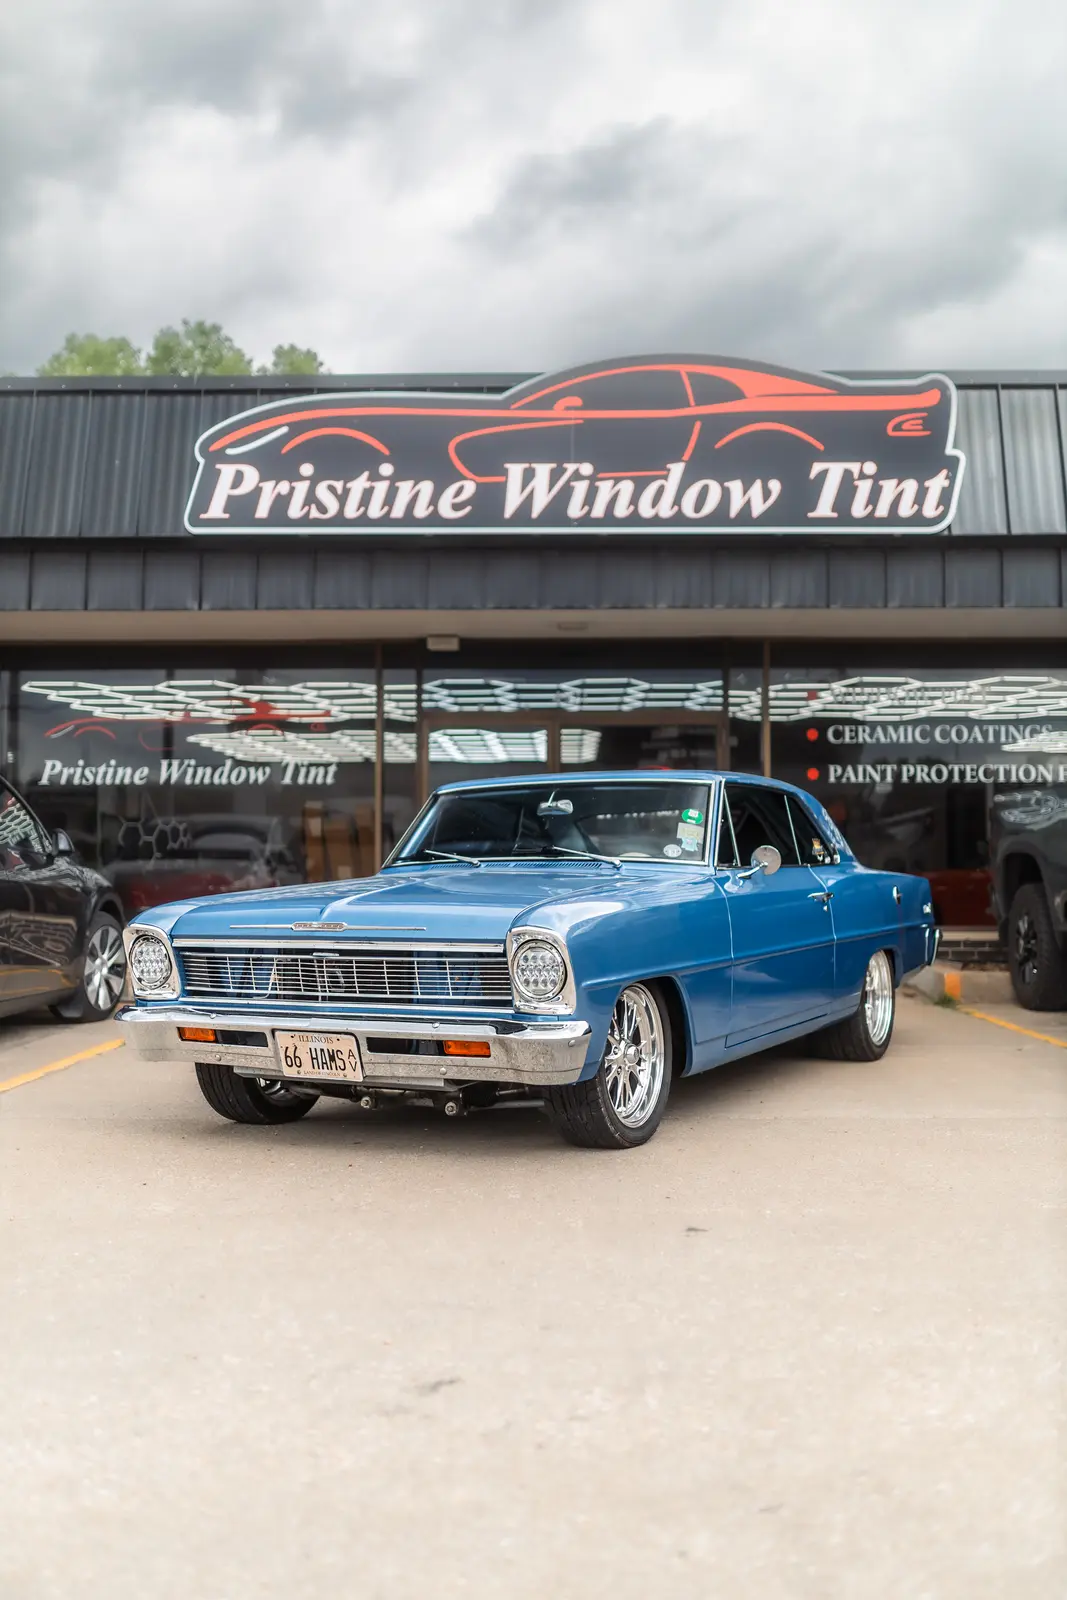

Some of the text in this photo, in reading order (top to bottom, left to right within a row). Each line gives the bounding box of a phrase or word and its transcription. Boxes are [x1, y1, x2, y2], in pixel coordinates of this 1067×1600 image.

[199, 460, 951, 520] Pristine Window Tint
[826, 724, 930, 744] CERAMIC
[38, 758, 339, 786] Pristine Window Tint
[827, 763, 897, 784] PAINT
[901, 763, 1053, 784] PROTECTION
[298, 1034, 334, 1044] ILLINOIS
[284, 1046, 346, 1071] 66 HAMS
